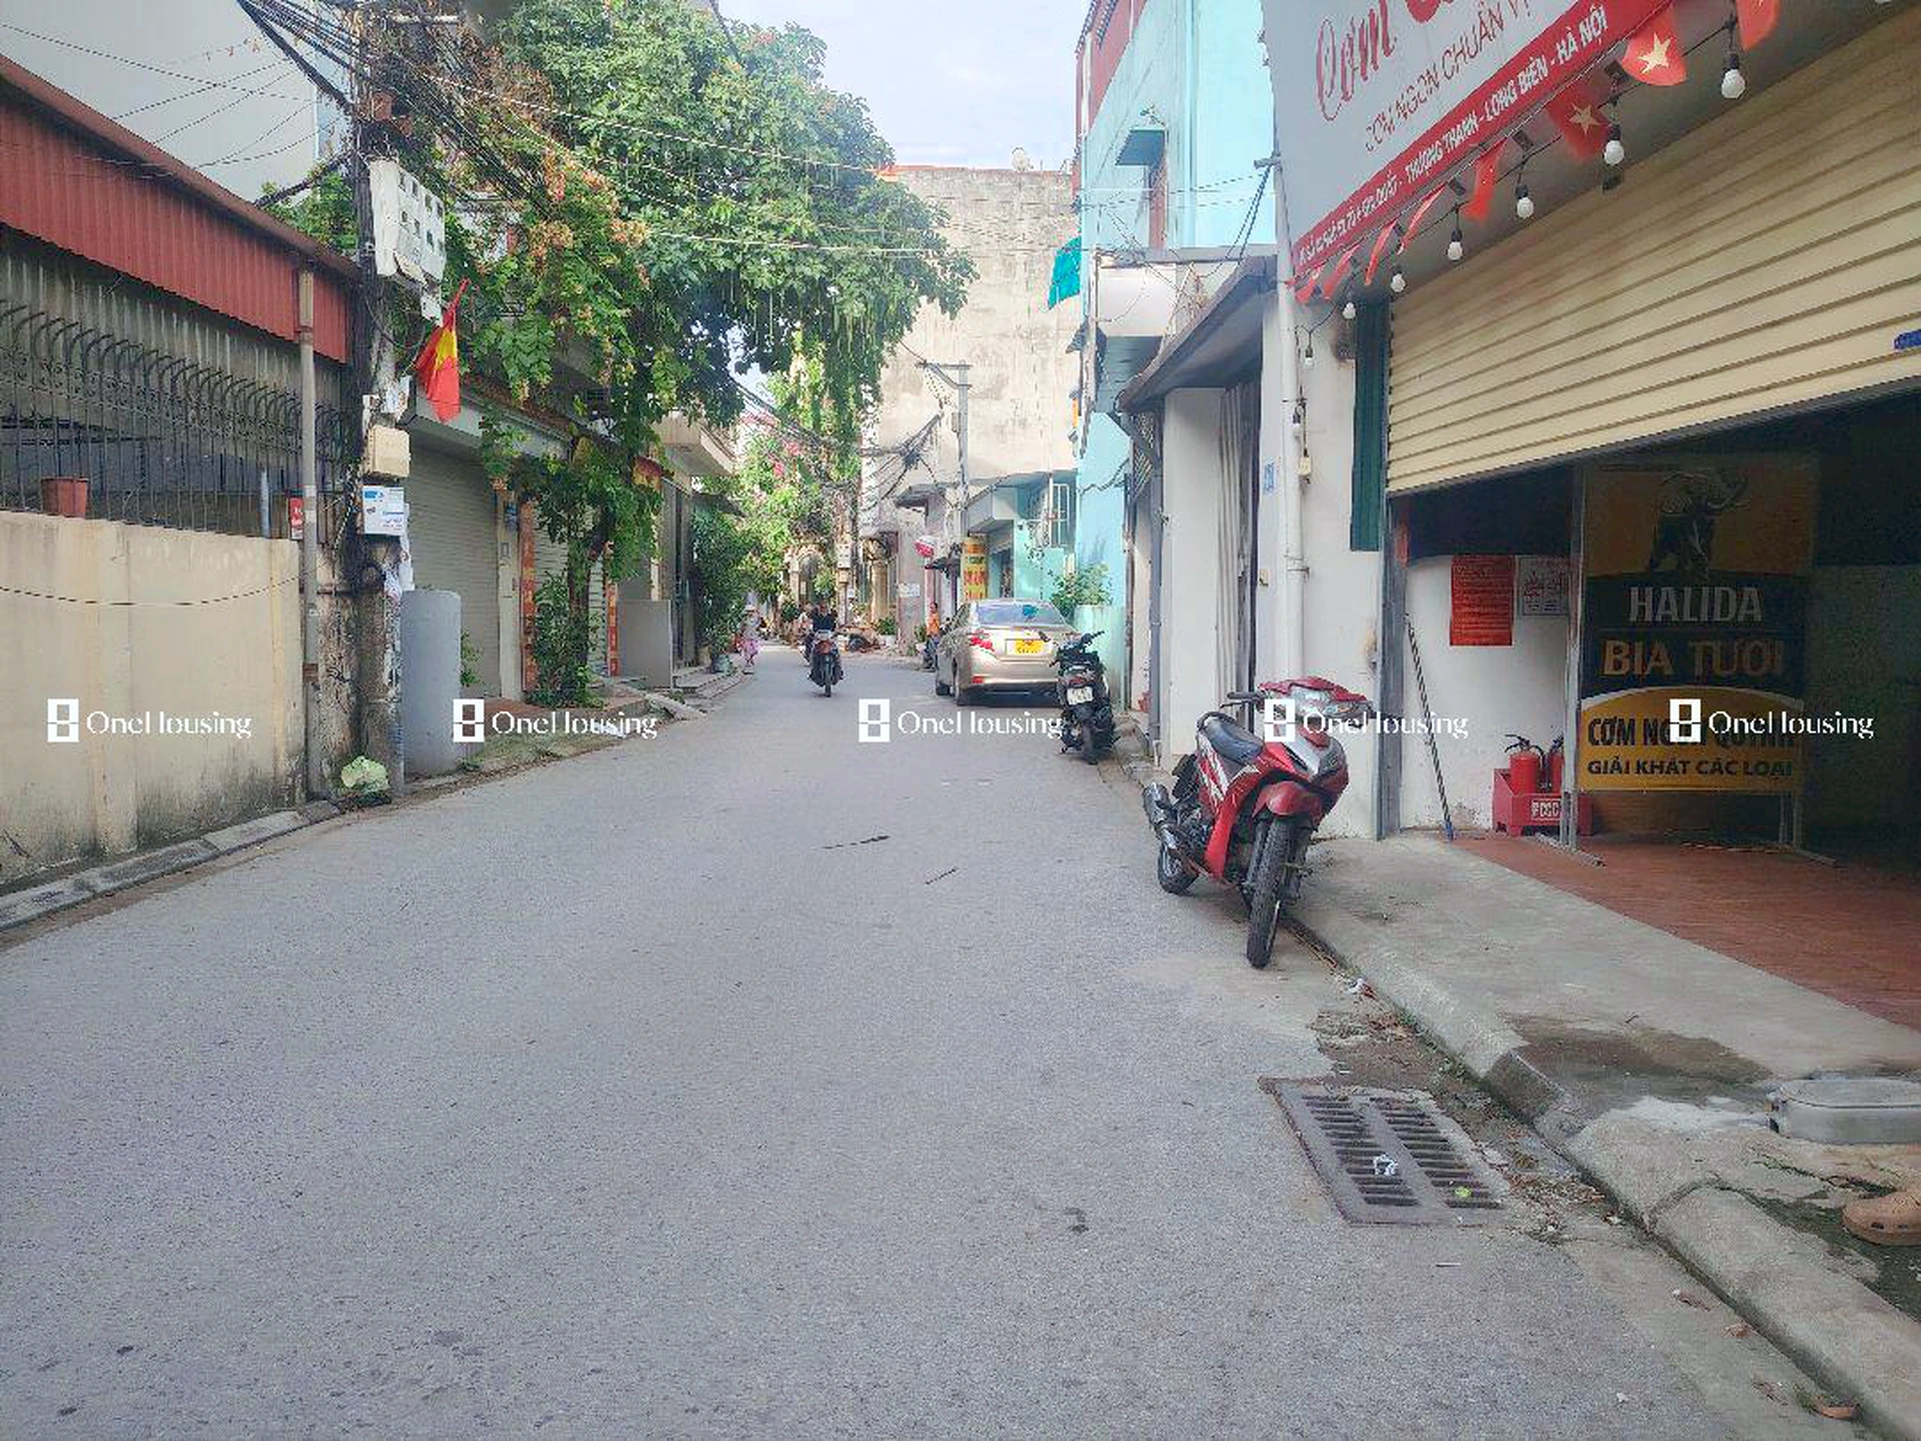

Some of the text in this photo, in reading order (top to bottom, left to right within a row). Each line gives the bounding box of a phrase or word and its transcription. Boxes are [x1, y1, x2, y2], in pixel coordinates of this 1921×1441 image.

[1629, 586, 1764, 622] HALIDA
[1602, 640, 1674, 678] BIA
[1587, 716, 1635, 747] CƠM
[1587, 755, 1630, 776] GIẢI
